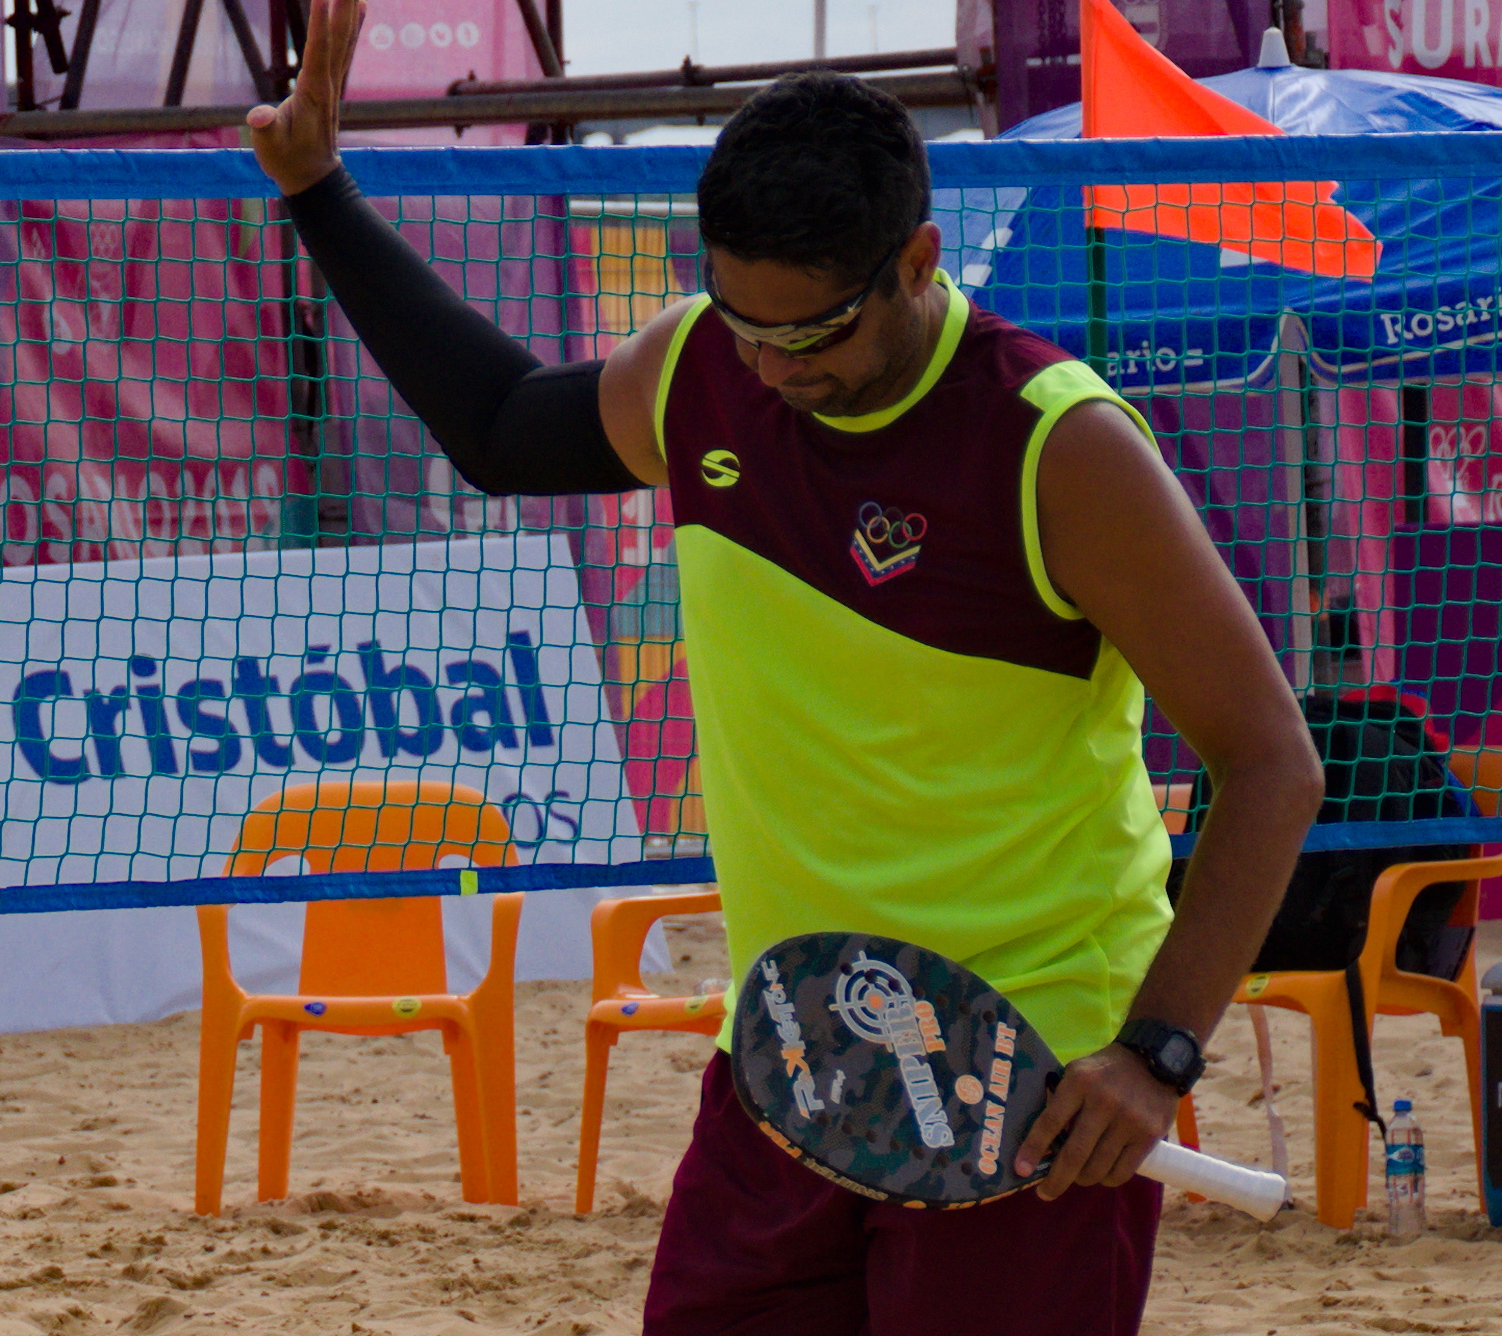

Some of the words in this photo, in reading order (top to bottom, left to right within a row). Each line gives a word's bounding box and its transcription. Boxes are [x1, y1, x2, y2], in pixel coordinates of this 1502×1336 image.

[10, 628, 555, 787] Cristóbal
[915, 999, 946, 1054] PRO
[995, 1021, 1017, 1057] BT
[988, 1059, 1012, 1102] AIR
[978, 1101, 1006, 1175] OCEAN
